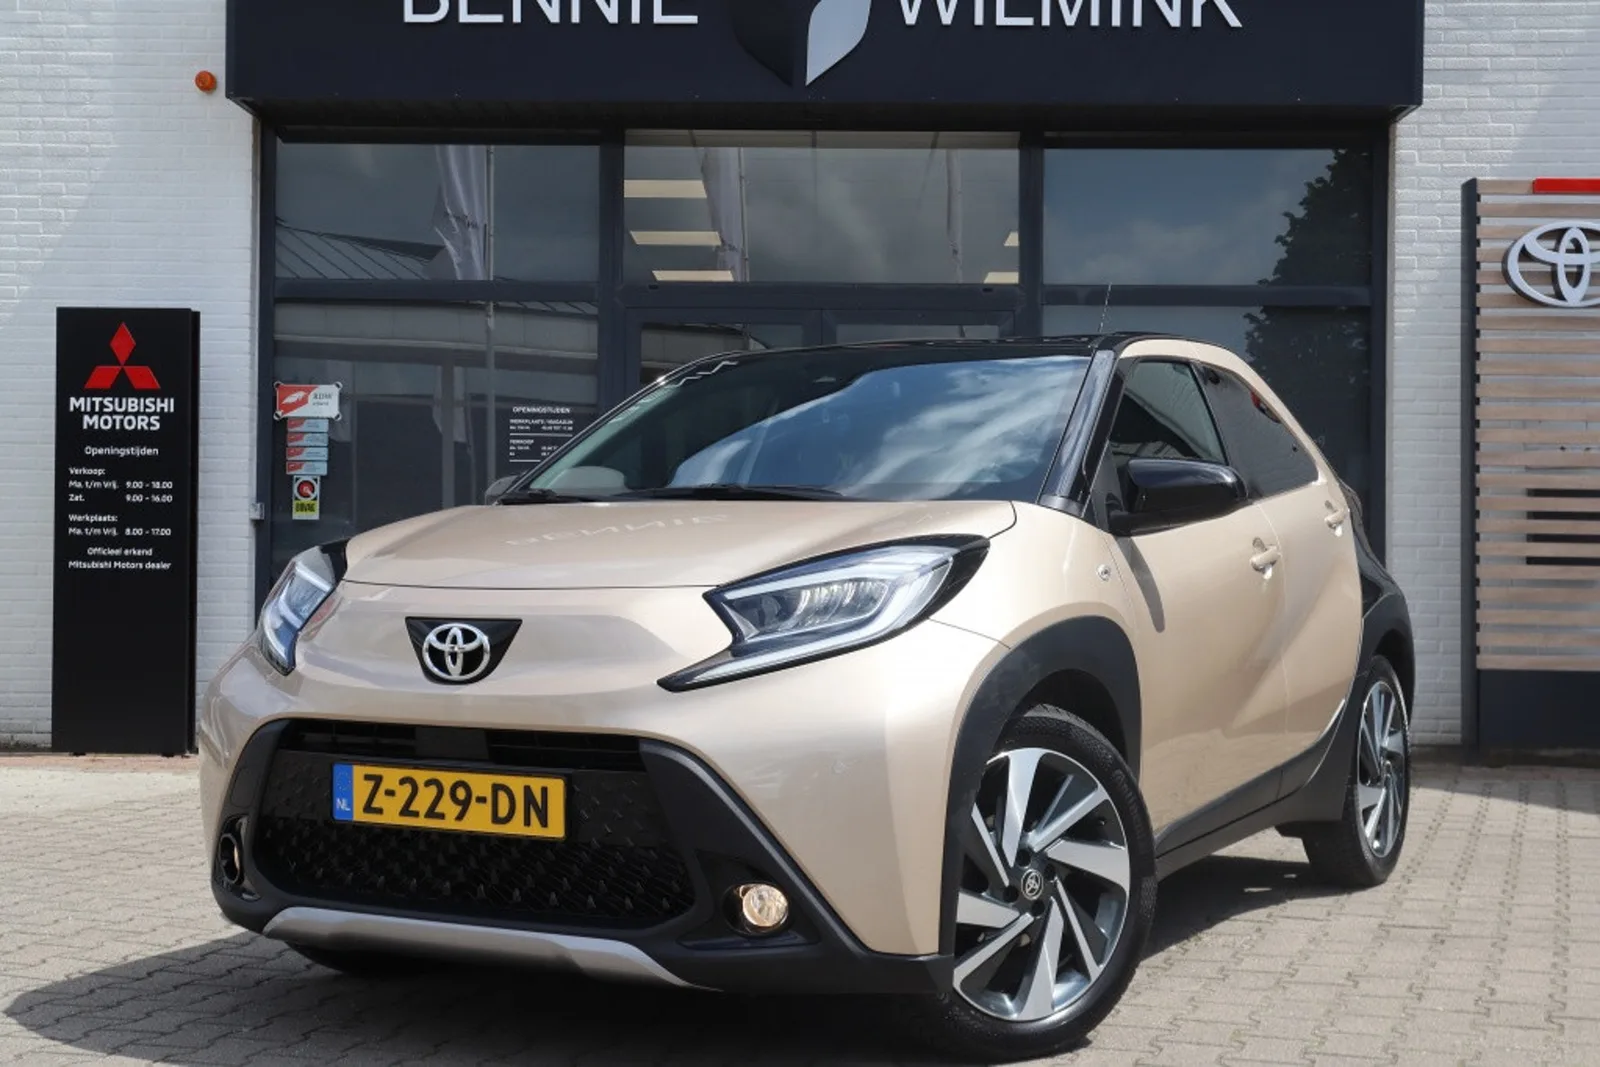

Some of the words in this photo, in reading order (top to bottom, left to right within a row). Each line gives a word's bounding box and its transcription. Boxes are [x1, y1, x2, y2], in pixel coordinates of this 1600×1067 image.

[69, 396, 175, 413] MITSUBISHI
[82, 414, 161, 431] MOTORS
[84, 445, 159, 458] Openingstijden
[68, 467, 106, 477] Verkoop:
[68, 514, 118, 523] Werkplaats:
[87, 547, 122, 556] Officieel
[123, 547, 153, 556] erkend
[68, 561, 112, 569] Mitsubishi
[113, 561, 143, 569] Motors
[144, 561, 172, 570] dealer
[335, 797, 351, 812] NL
[362, 773, 549, 829] Z-229-DN
